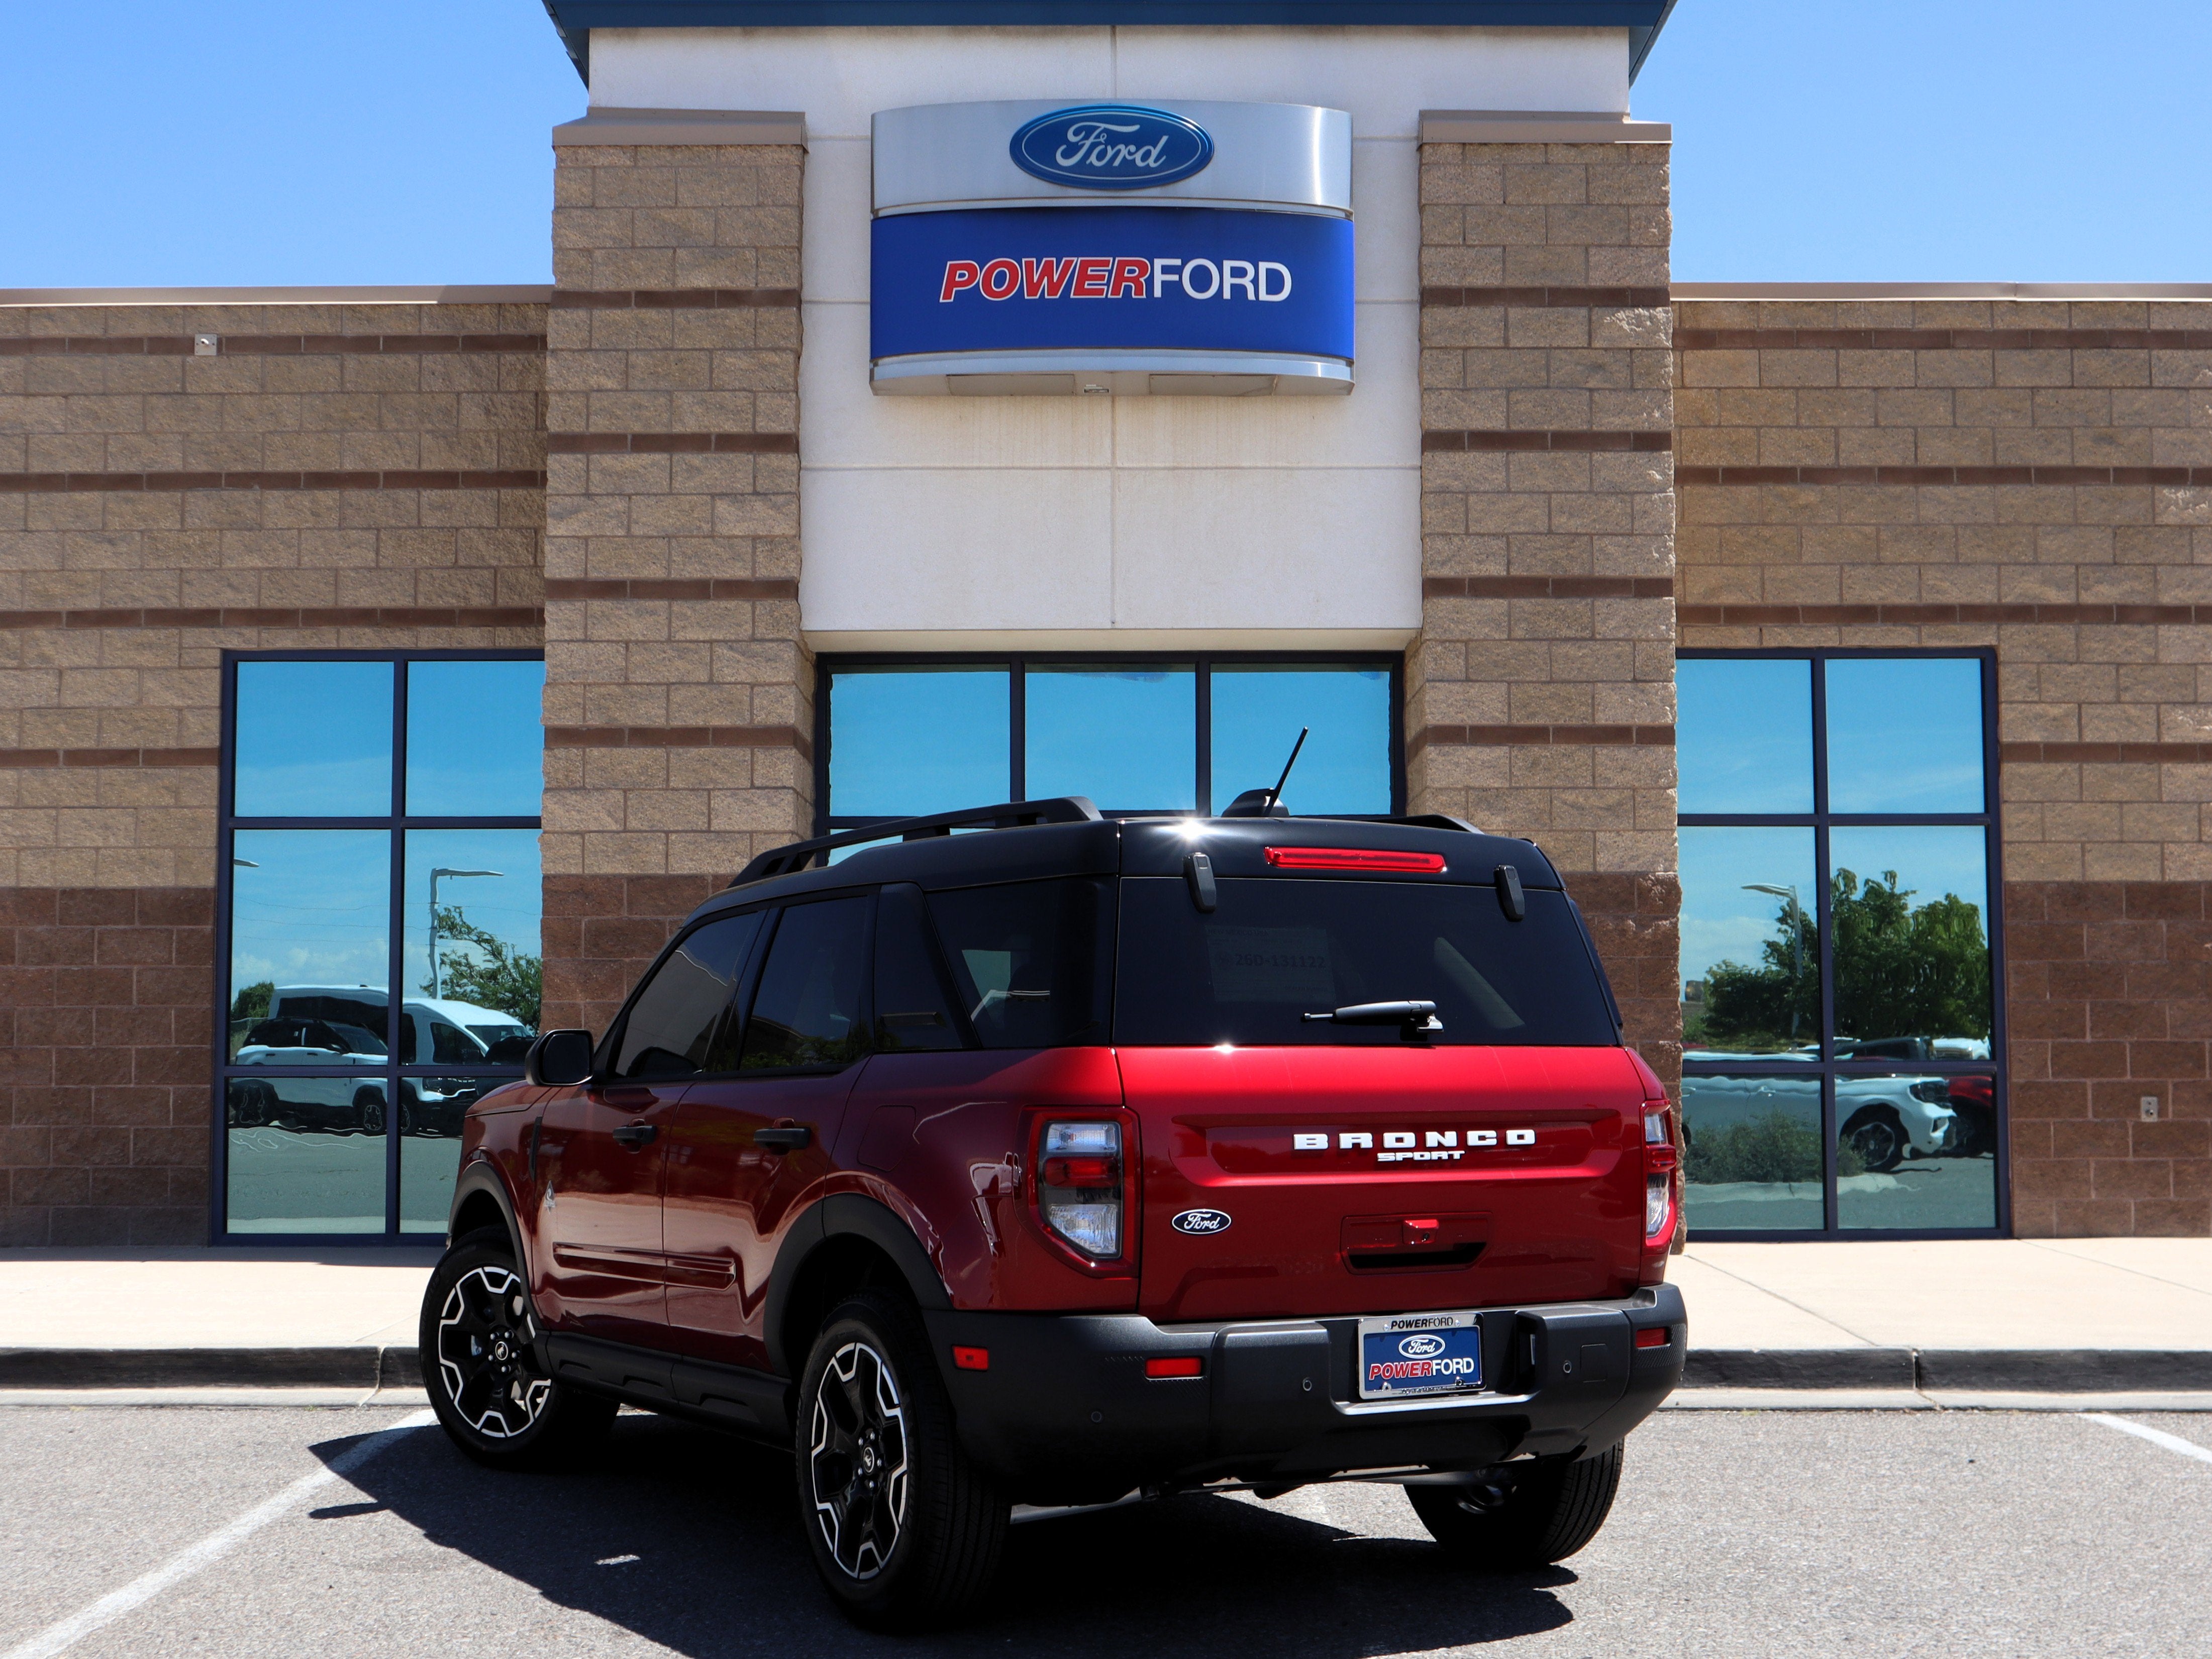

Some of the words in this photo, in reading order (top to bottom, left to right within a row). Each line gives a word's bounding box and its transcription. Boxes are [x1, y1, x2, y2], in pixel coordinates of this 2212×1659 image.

[1056, 121, 1169, 167] Ford
[939, 257, 1292, 302] POWERFORD
[1293, 1129, 1536, 1150] BRONCO
[1377, 1151, 1465, 1162] SPORT
[1184, 1213, 1221, 1229] Ford
[1390, 1317, 1453, 1329] POWERFORD
[1408, 1339, 1436, 1354] Ford
[1369, 1358, 1474, 1381] POWERFORD
